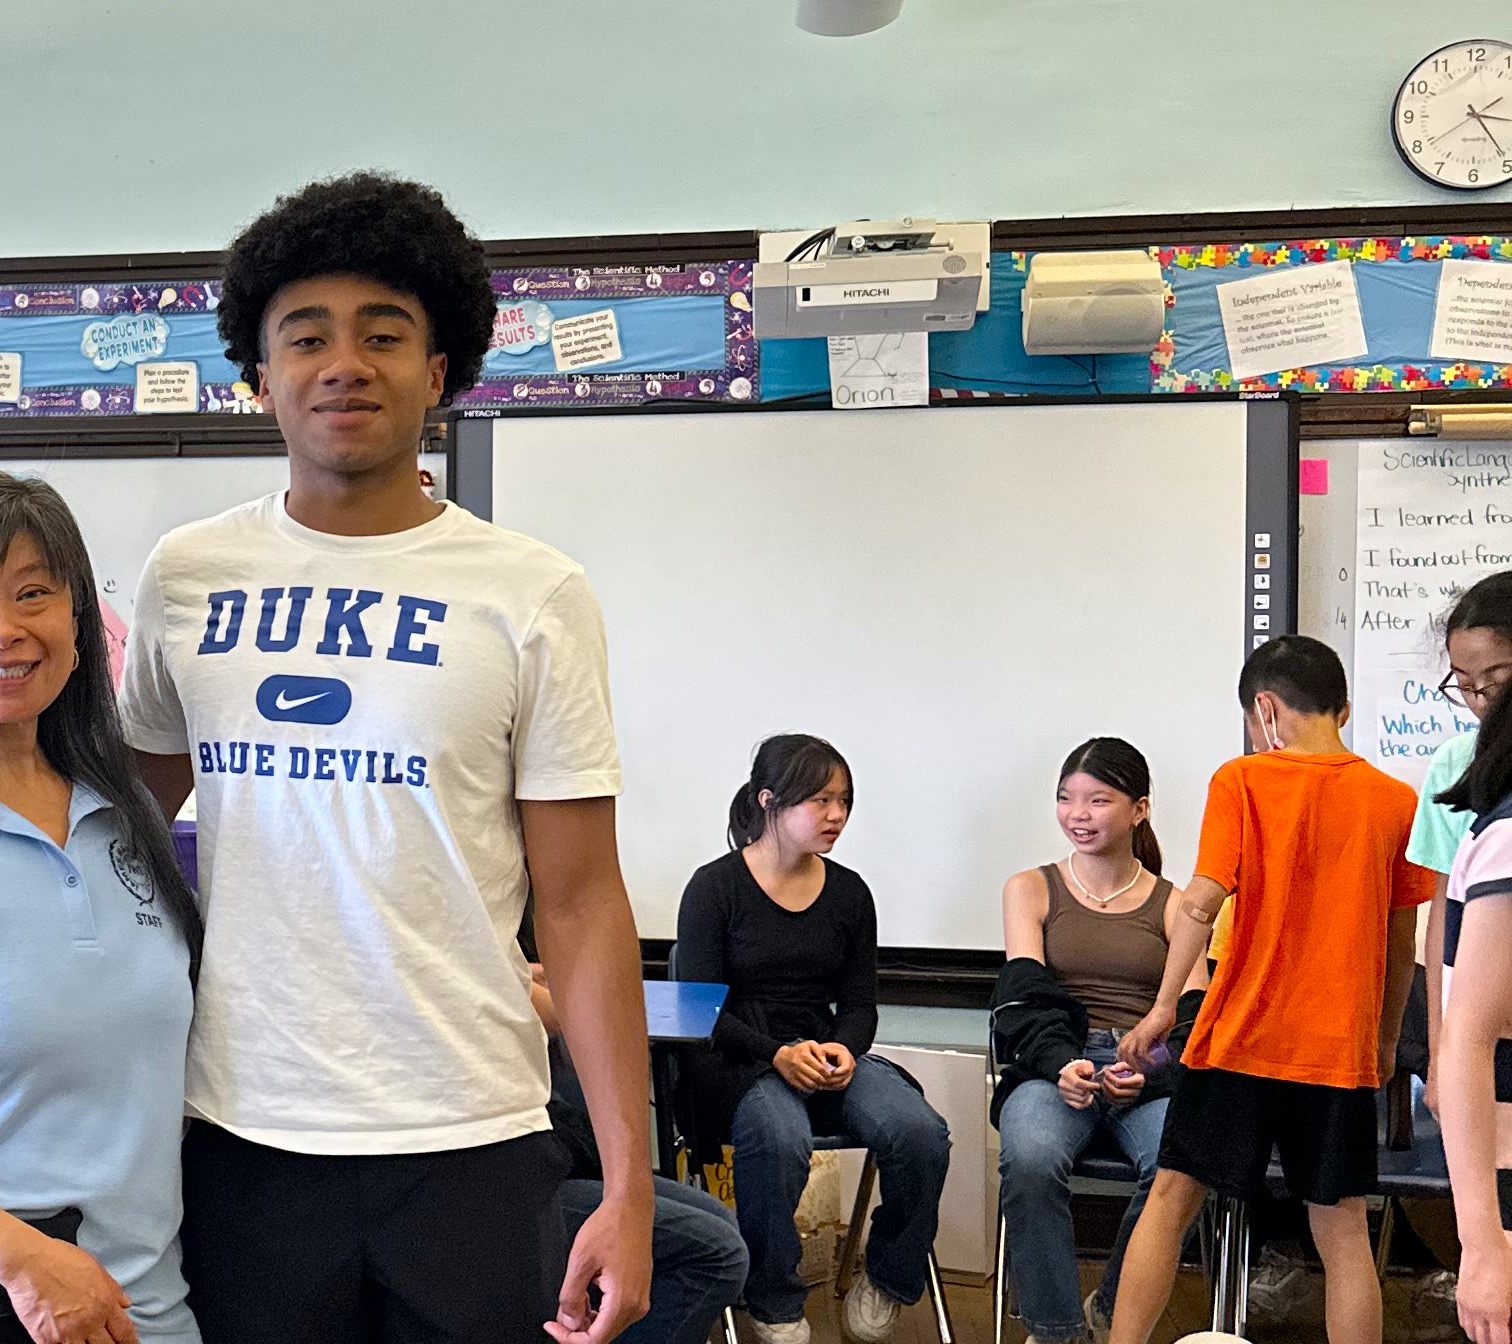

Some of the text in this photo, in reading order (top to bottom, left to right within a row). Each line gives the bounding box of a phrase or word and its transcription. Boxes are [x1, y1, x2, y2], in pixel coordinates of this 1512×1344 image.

[1467, 48, 1486, 62] 12
[1433, 59, 1448, 72] 11
[1410, 81, 1427, 94] 10
[1404, 110, 1414, 124] 9
[1413, 140, 1422, 154] 8
[1434, 162, 1445, 175] 7
[1503, 161, 1512, 173] 5
[1468, 169, 1478, 182] 6
[572, 268, 590, 276] The
[645, 265, 680, 274] Method
[528, 280, 570, 289] Question
[843, 288, 890, 297] HITACHI
[494, 307, 525, 328] HARE
[91, 319, 156, 343] CONDUCT AN
[98, 337, 158, 361] EXPERIMENT
[644, 372, 680, 380] Method
[528, 386, 569, 395] Question
[836, 385, 894, 405] Orion
[1458, 448, 1512, 472] Lang
[1368, 504, 1512, 527] I learned fro
[1365, 549, 1380, 567] I
[1390, 548, 1437, 568] found
[1441, 549, 1471, 566] out
[1364, 581, 1428, 598] That's
[198, 587, 448, 666] DUKE
[1361, 610, 1414, 630] After
[1383, 715, 1442, 735] Which
[1380, 739, 1413, 757] the
[200, 741, 275, 776] BLUE
[136, 912, 162, 928] STAFF
